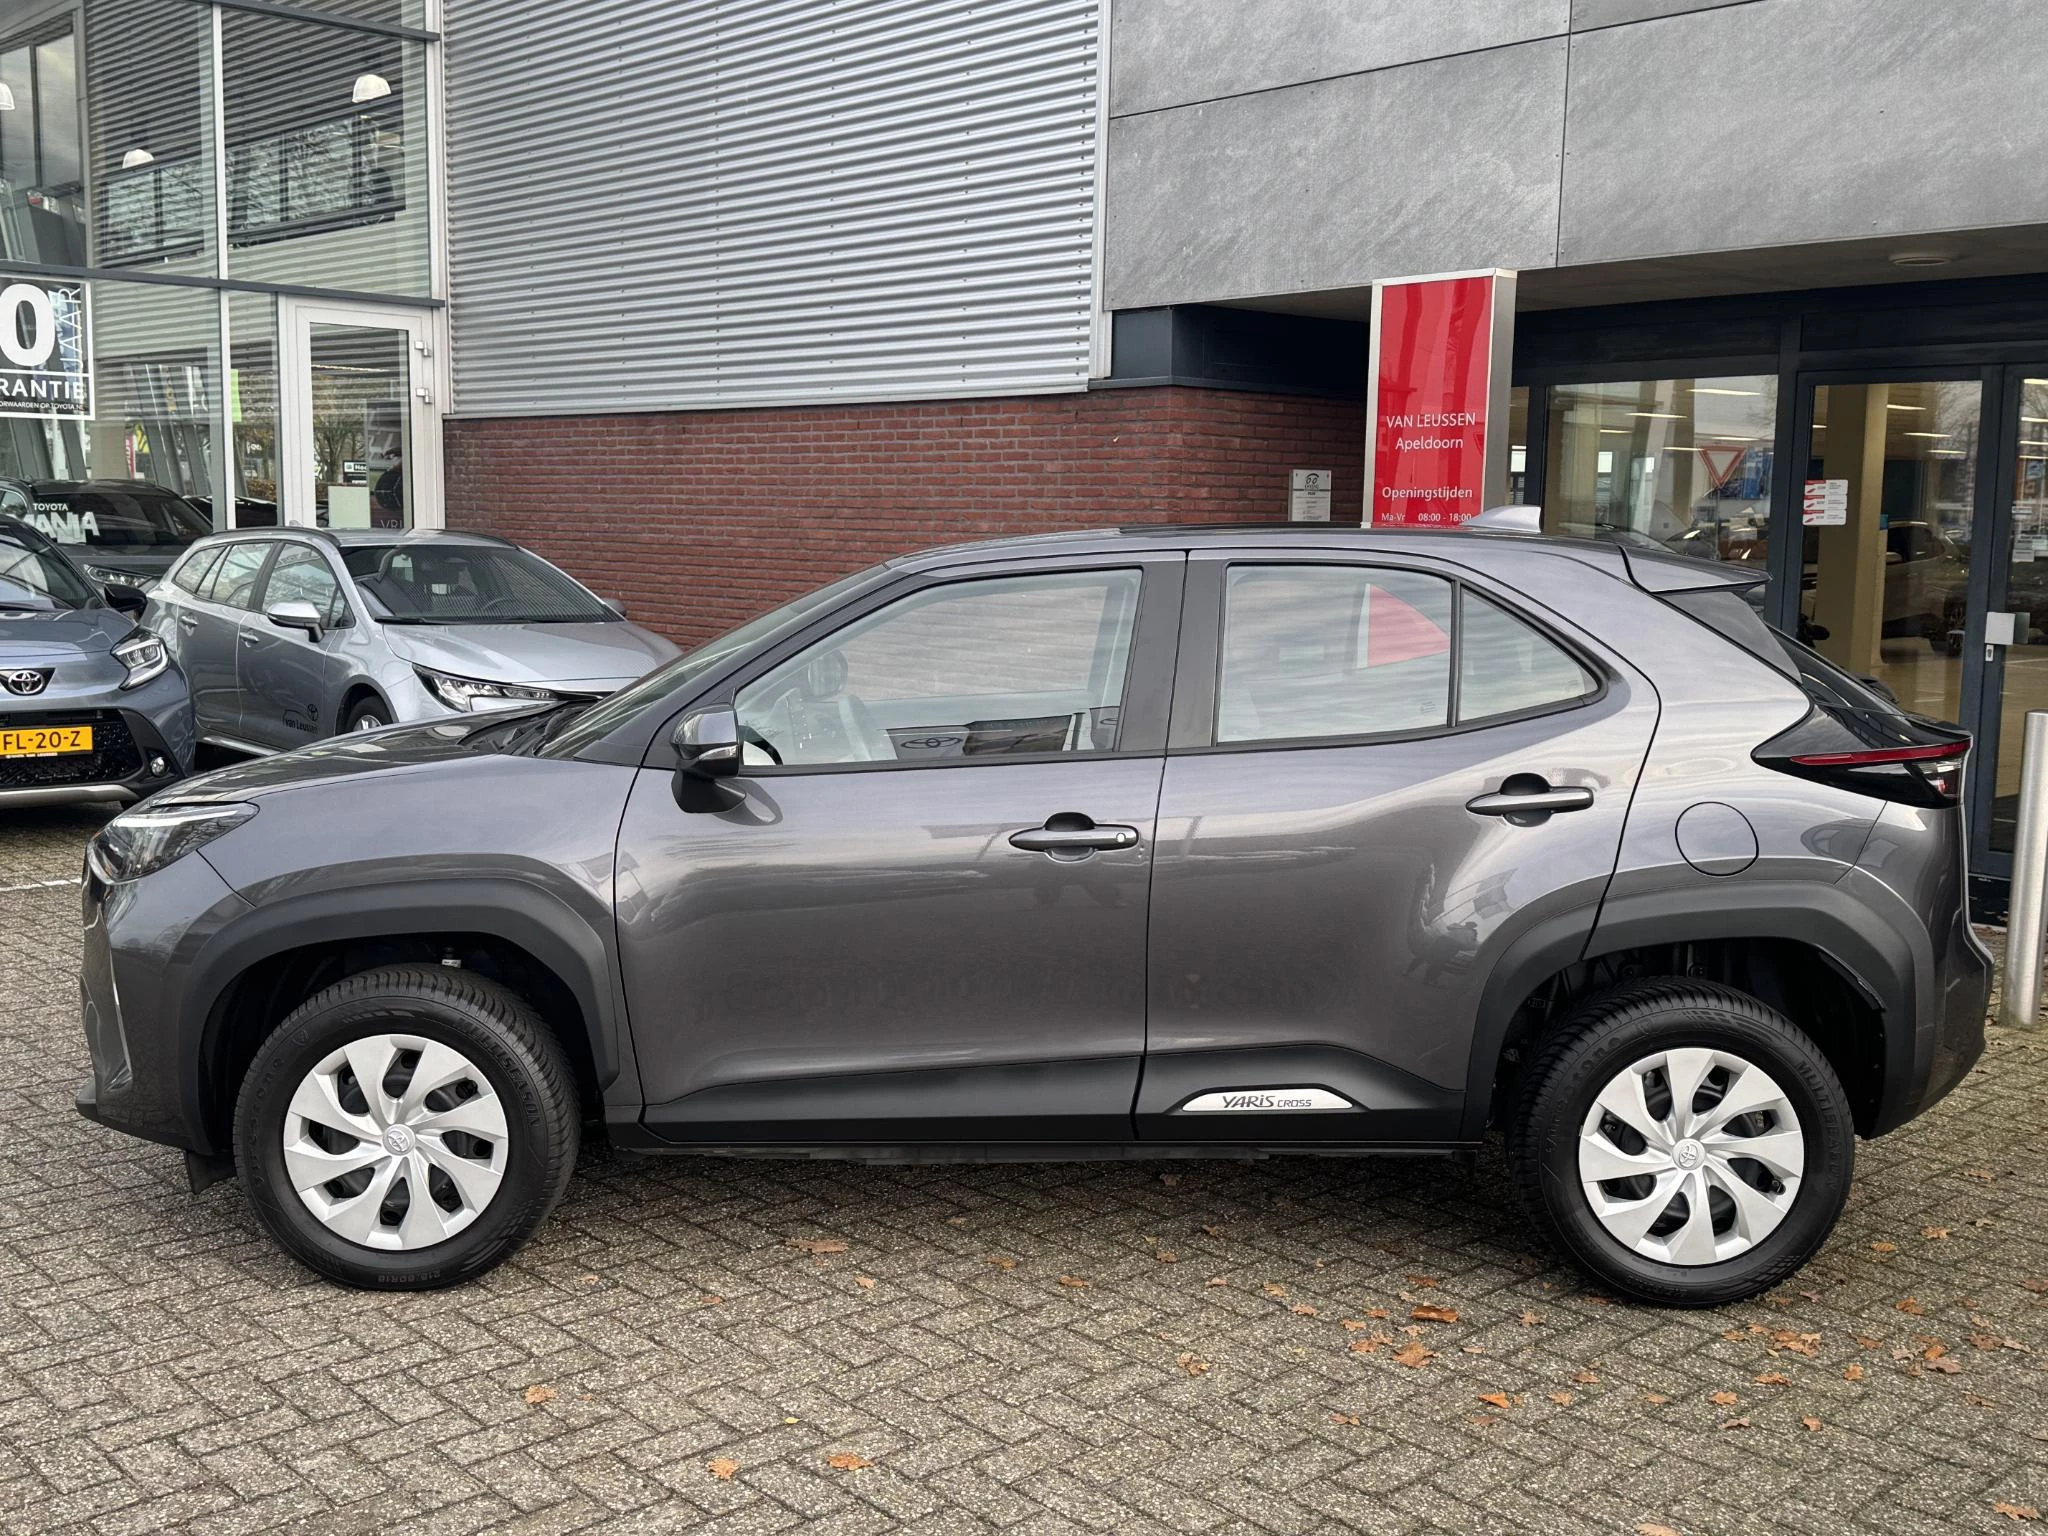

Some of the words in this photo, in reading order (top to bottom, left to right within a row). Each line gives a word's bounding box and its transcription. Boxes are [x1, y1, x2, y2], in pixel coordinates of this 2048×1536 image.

[0, 283, 55, 367] 0
[59, 288, 83, 369] JAAR
[0, 378, 84, 399] RANTIE
[1386, 414, 1413, 428] VAN
[1417, 412, 1476, 427] LEUSSEN
[1395, 435, 1464, 452] Apeldoorn
[1382, 486, 1473, 501] Openingstijden
[33, 503, 69, 511] TOYOTA
[1381, 513, 1406, 521] Ma-Vr
[1418, 512, 1441, 522] 08:00
[1449, 512, 1472, 522] 18:00
[3, 731, 81, 751] FL-20-Z
[1277, 1099, 1312, 1108] CROSS
